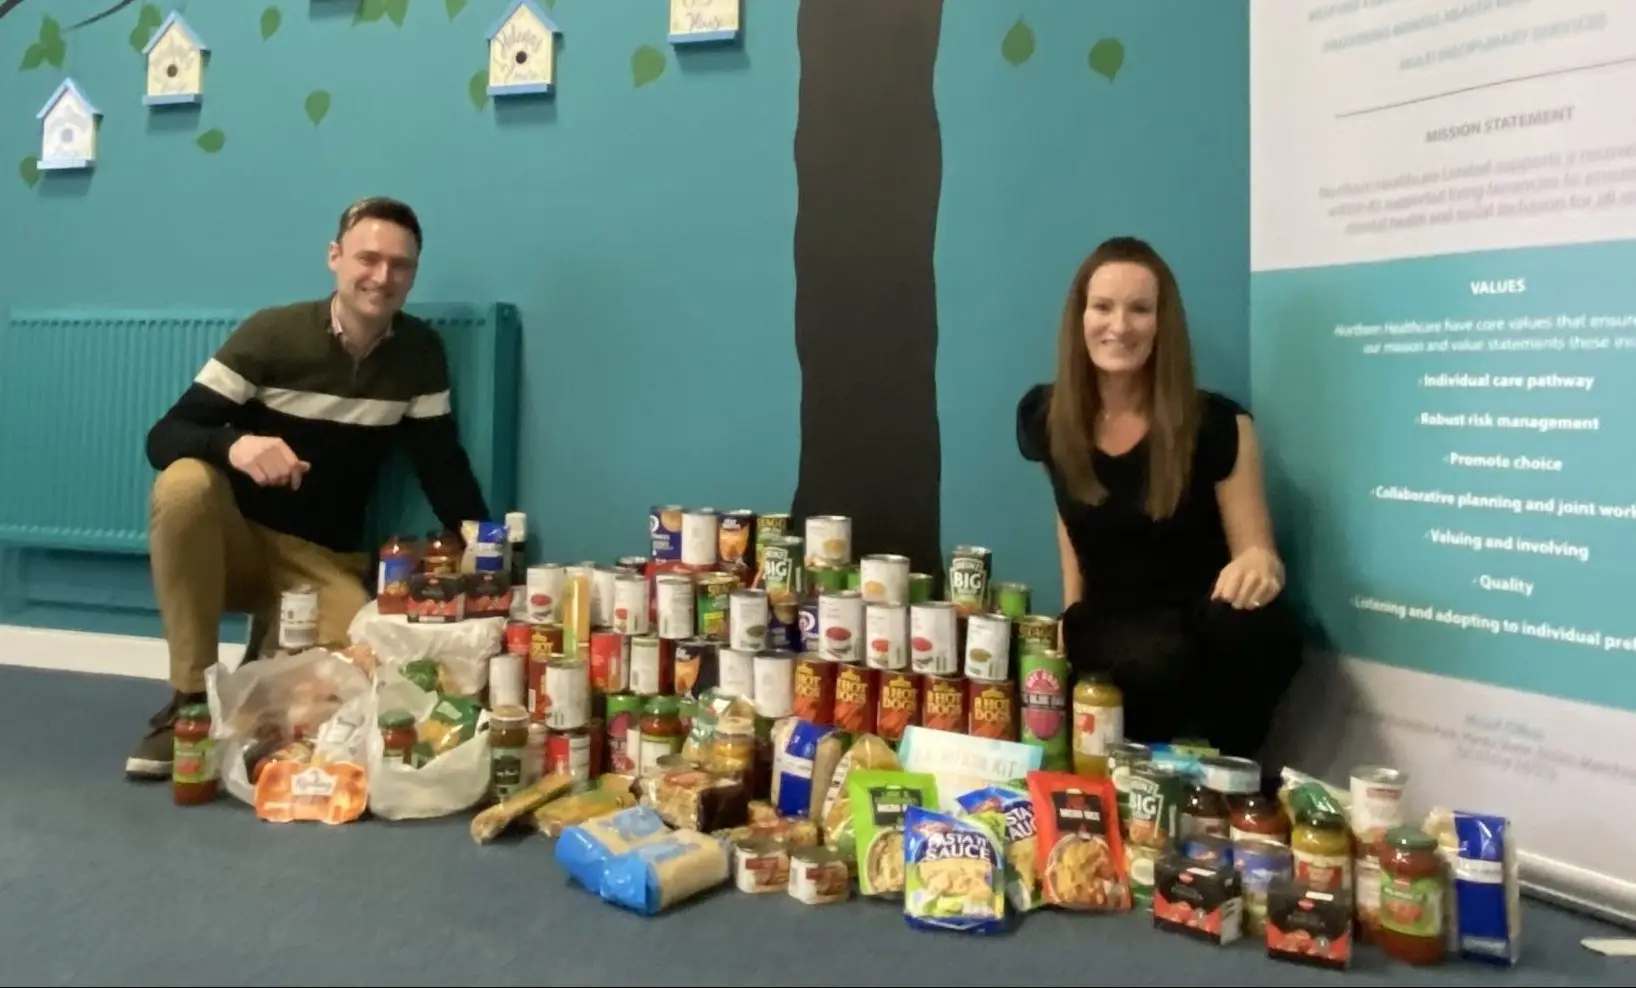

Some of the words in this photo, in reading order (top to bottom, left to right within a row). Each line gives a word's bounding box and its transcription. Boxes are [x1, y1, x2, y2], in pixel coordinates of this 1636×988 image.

[1425, 121, 1481, 143] MISSION
[1484, 106, 1576, 134] STATEMENT
[1470, 278, 1526, 295] VALUES
[1444, 318, 1473, 333] have
[1476, 318, 1505, 331] core
[1508, 315, 1553, 331] values
[1556, 313, 1587, 329] that
[1487, 335, 1566, 352] statements
[1423, 373, 1491, 389] Individual
[1493, 376, 1523, 389] care
[1526, 374, 1595, 392] pathway
[1420, 412, 1466, 427] Robust
[1468, 412, 1493, 428] risk
[1496, 416, 1600, 432] management
[1450, 453, 1510, 469] Promote
[1513, 455, 1564, 472] choice
[1376, 485, 1456, 506] Collaborative
[1457, 492, 1523, 513] planning
[1525, 497, 1555, 513] and
[1557, 500, 1597, 517] joint
[1430, 528, 1483, 551] Valuing
[1485, 535, 1514, 551] and
[1516, 537, 1589, 562] involving
[954, 571, 982, 590] BIG
[1479, 574, 1534, 597] Quality
[1354, 596, 1407, 619] Listening
[1408, 605, 1434, 621] and
[1435, 610, 1500, 635] adopting
[1502, 620, 1519, 634] to
[1521, 621, 1601, 646] individual
[1129, 791, 1157, 815] BIG
[926, 844, 992, 861] SAUCE
